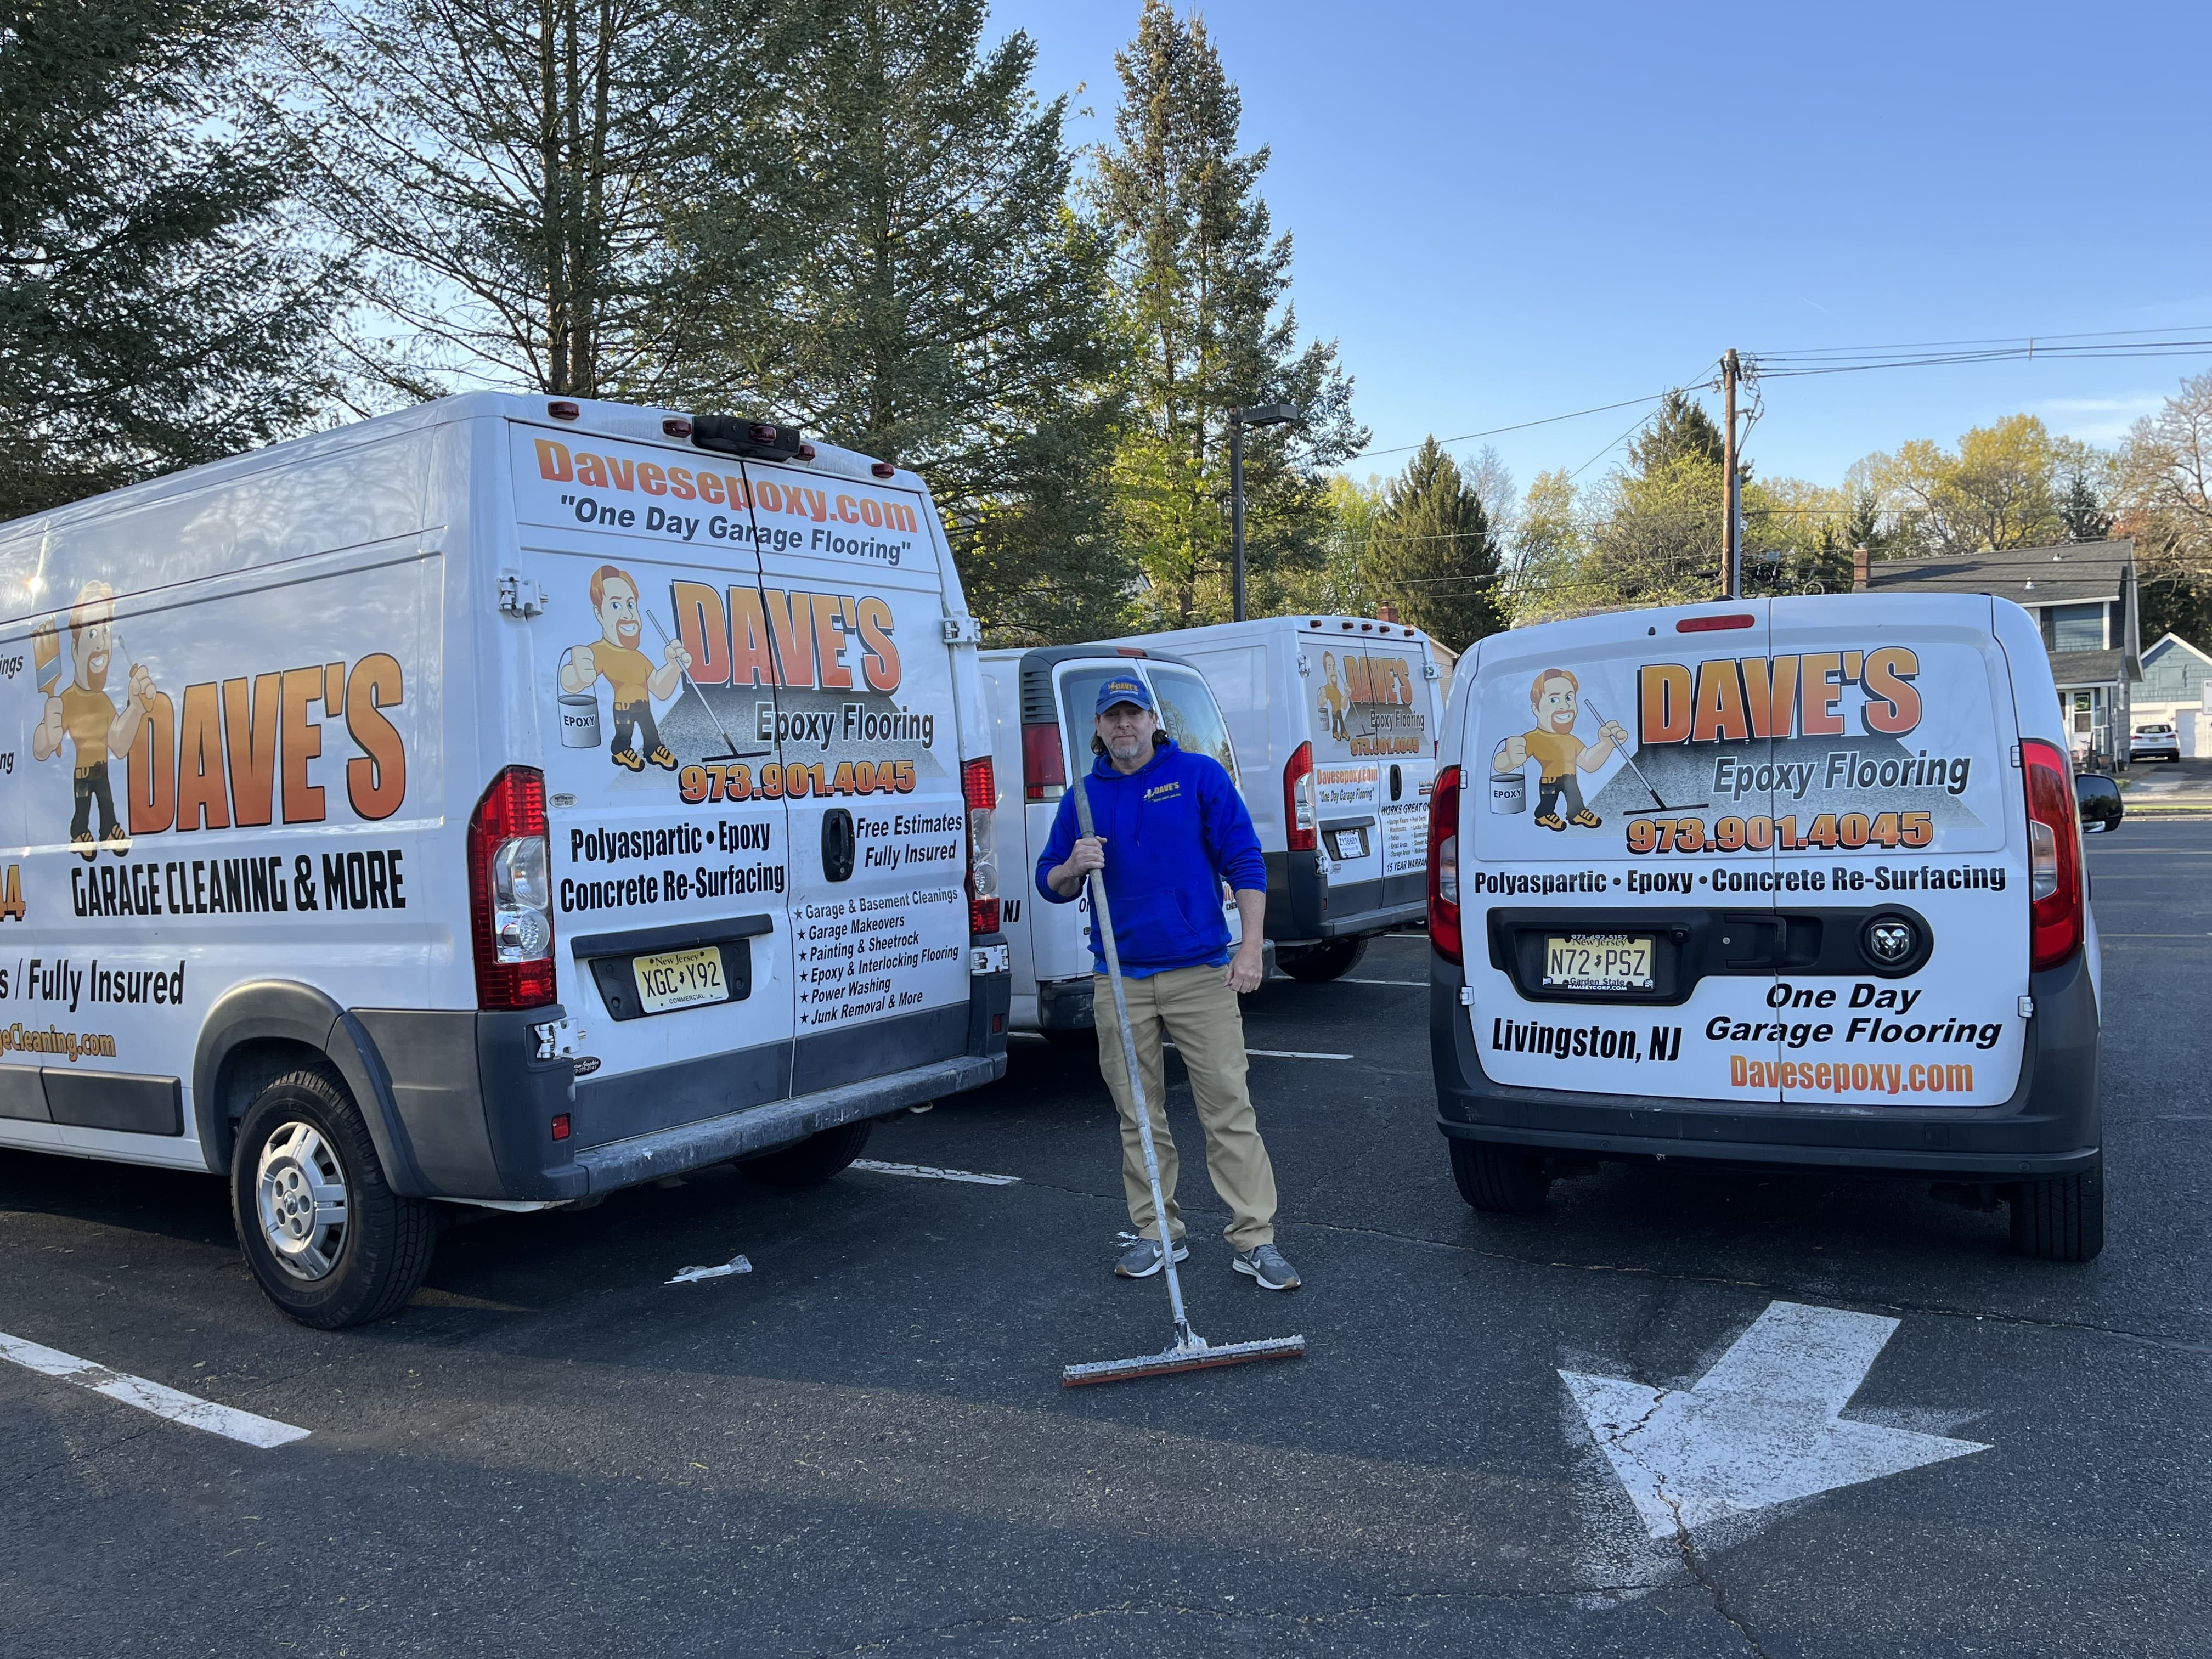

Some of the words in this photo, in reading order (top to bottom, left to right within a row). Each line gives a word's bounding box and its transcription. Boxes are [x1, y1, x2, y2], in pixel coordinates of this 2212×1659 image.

[534, 438, 917, 533] Davesepoxy.com
[561, 495, 635, 528] "One
[646, 506, 699, 541] Day
[709, 516, 802, 552] Garage
[811, 528, 911, 566] Flooring"
[669, 579, 901, 698] DAVE'S
[1343, 656, 1413, 707] DAVE'S
[1637, 647, 1922, 752] DAVE'S
[563, 715, 595, 727] EPOXY
[755, 702, 836, 752] Epoxy
[842, 702, 934, 750] Flooring
[1370, 709, 1393, 732] Epoxy
[1396, 709, 1424, 732] Flooring
[127, 652, 406, 836] DAVE'S
[1351, 736, 1419, 756] 973.901.4045
[679, 760, 916, 805] 973.901.4045
[1154, 781, 1179, 794] DAVE'S
[1317, 769, 1378, 785] Davesepoxy.com
[1712, 755, 1816, 802] Epoxy
[1822, 750, 1971, 796] Flooring
[1340, 789, 1355, 803] Garage
[1381, 804, 1402, 816] WORKS
[1403, 802, 1423, 814] GREAT
[1494, 788, 1521, 798] EPOXY
[856, 817, 889, 838] Free
[894, 813, 962, 836] Estimates
[1626, 811, 1933, 854] 973.901.4045
[571, 823, 702, 863] Polyaspartic
[719, 821, 770, 854] Epoxy
[865, 845, 901, 871] Fully
[905, 839, 957, 864] Insured
[1387, 861, 1393, 872] 15
[1394, 860, 1407, 871] YEAR
[1475, 871, 1607, 895] Polyaspartic
[1627, 870, 1693, 894] Epoxy
[1712, 868, 1825, 892] Concrete
[1832, 864, 2006, 892] Re-Surfacing
[71, 863, 162, 917] GARAGE
[166, 856, 288, 914] CLEANING
[294, 855, 318, 912] &
[321, 849, 406, 911] MORE
[560, 874, 658, 913] Concrete
[663, 862, 785, 902] Re-Surfacing
[805, 904, 845, 919] Garage
[849, 899, 856, 913] &
[860, 893, 910, 912] Basement
[912, 888, 958, 905] Cleanings
[1003, 900, 1021, 923] NJ
[809, 924, 847, 941] Garage
[851, 915, 905, 934] Makeovers
[655, 957, 674, 967] New
[675, 955, 698, 966] Jersey
[810, 943, 854, 961] Painting
[857, 939, 865, 953] &
[868, 930, 919, 952] Sheetrock
[642, 967, 678, 997] XGC
[686, 961, 720, 990] Y92
[811, 966, 844, 985] Epoxy
[848, 961, 854, 976] &
[859, 952, 918, 974] Interlocking
[921, 945, 959, 963] Flooring
[1551, 949, 1590, 975] N72
[1605, 950, 1646, 977] PSZ
[29, 958, 82, 1012] Fully
[91, 959, 185, 1005] Insured
[811, 987, 845, 1004] Power
[849, 977, 891, 997] Washing
[1570, 977, 1599, 985] Garden
[669, 993, 706, 1005] COMMERCIAL
[811, 1006, 837, 1025] Junk
[841, 996, 885, 1019] Removal
[888, 994, 895, 1009] &
[899, 991, 923, 1006] More
[1766, 983, 1837, 1008] One
[1848, 983, 1922, 1015] Day
[1492, 1018, 1641, 1064] Livingston,
[1649, 1026, 1682, 1062] NJ
[1705, 1016, 1833, 1049] Garage
[1845, 1017, 2002, 1049] Flooring
[1730, 1054, 1973, 1095] Davesepoxy.com
